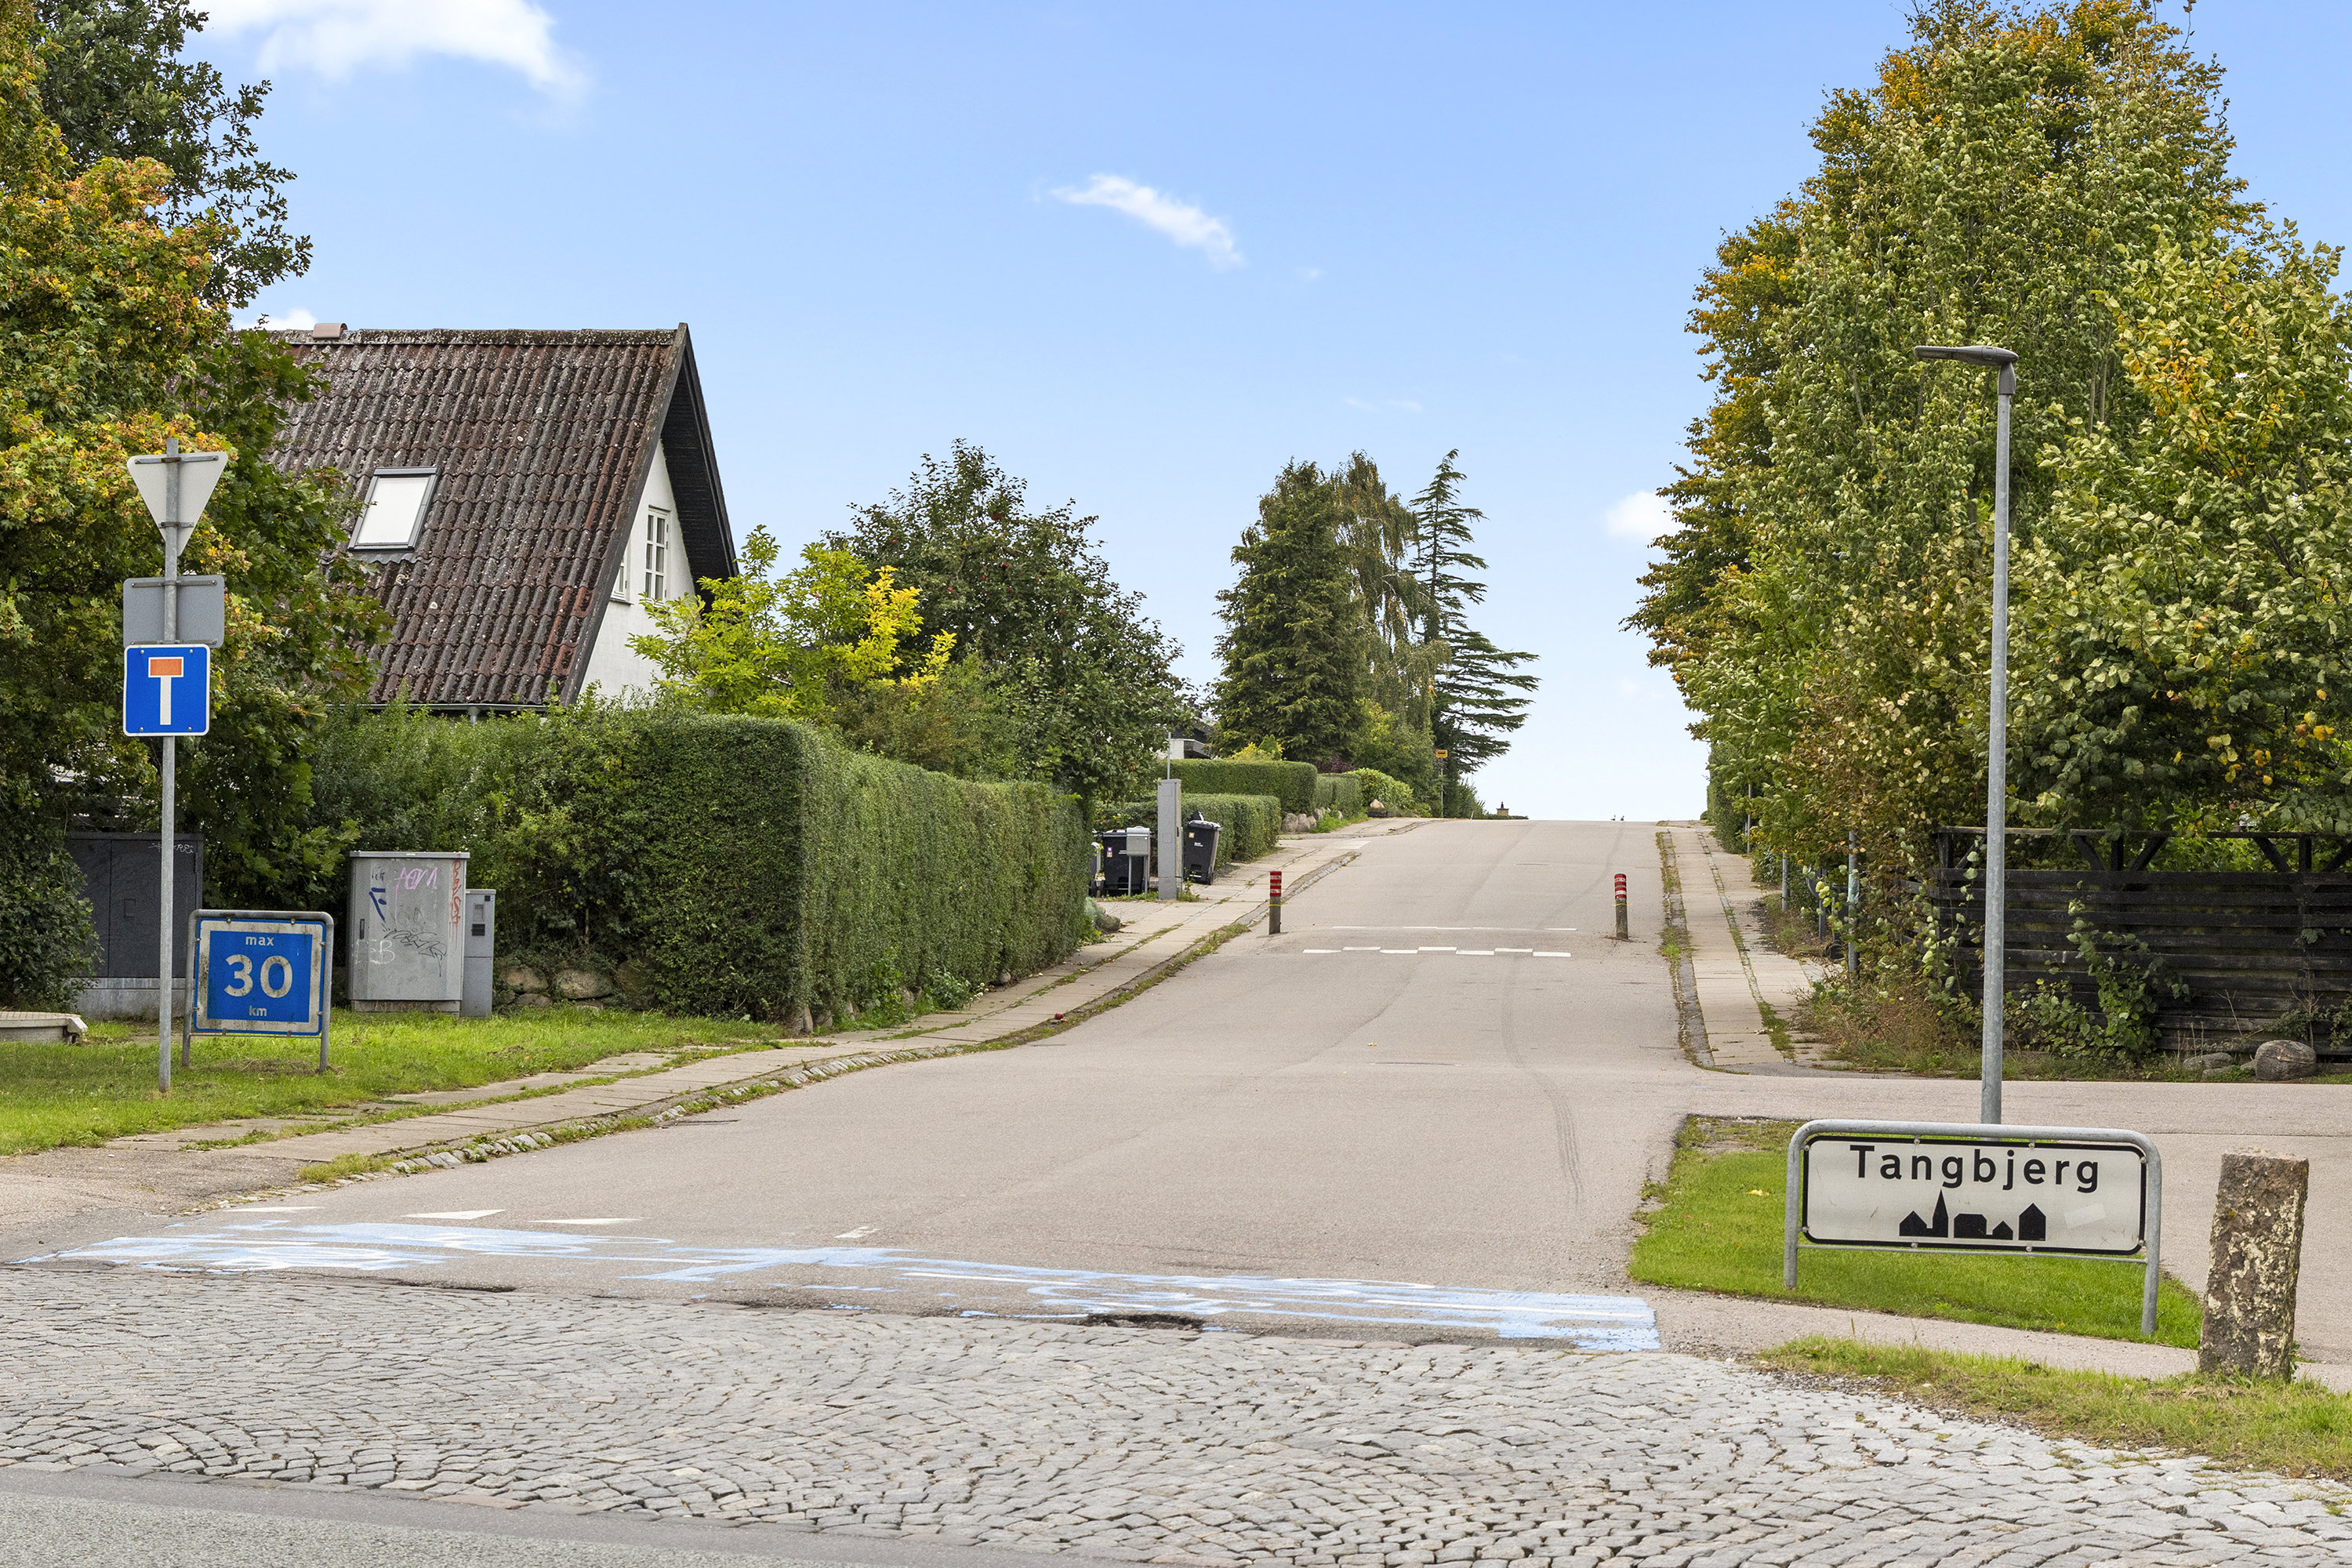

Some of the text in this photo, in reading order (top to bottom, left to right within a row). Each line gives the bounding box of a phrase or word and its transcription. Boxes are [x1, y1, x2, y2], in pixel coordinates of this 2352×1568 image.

[245, 936, 274, 946] max
[223, 954, 292, 998] 30
[249, 1005, 267, 1016] km
[1849, 1145, 2099, 1193] Tangbjerg
